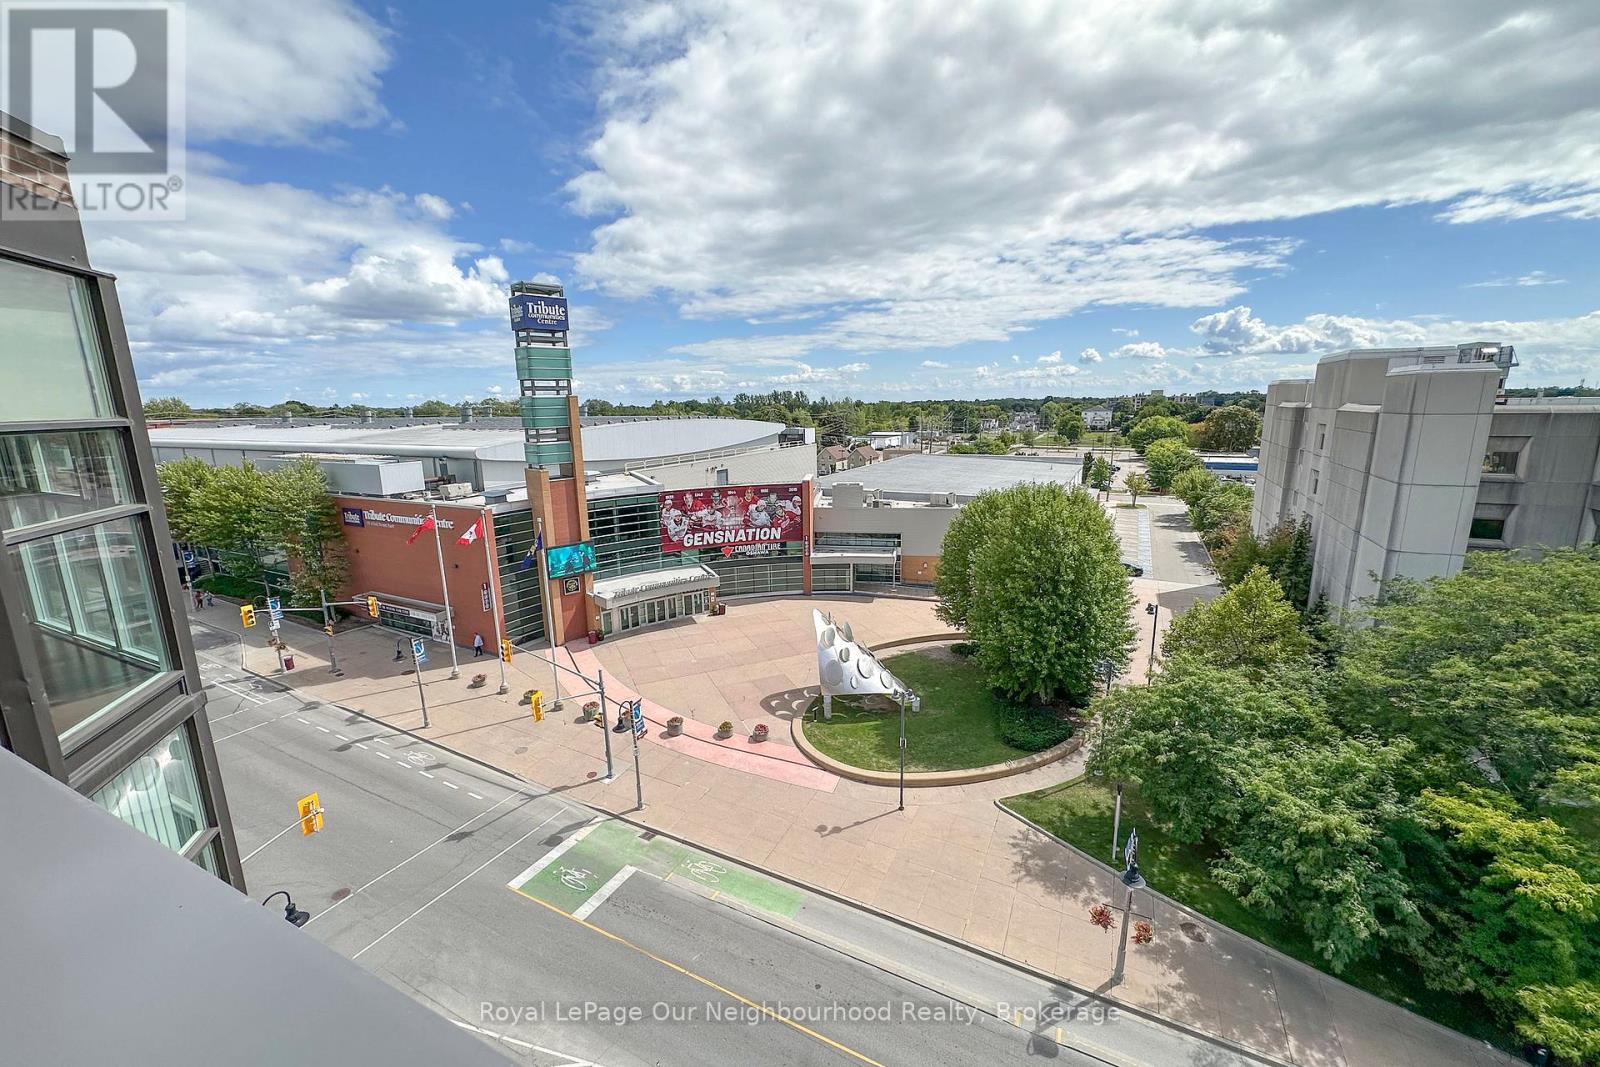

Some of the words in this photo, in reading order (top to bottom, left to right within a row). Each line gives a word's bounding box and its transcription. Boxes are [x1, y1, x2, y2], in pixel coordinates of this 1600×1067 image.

[526, 300, 566, 316] Tribute
[527, 313, 566, 321] Communities
[363, 510, 386, 521] Tribute
[386, 513, 426, 525] Communiti
[436, 519, 454, 529] entre
[683, 527, 782, 547] GENSNATION
[735, 542, 766, 553] CANADIAN
[766, 542, 781, 551] TIRE
